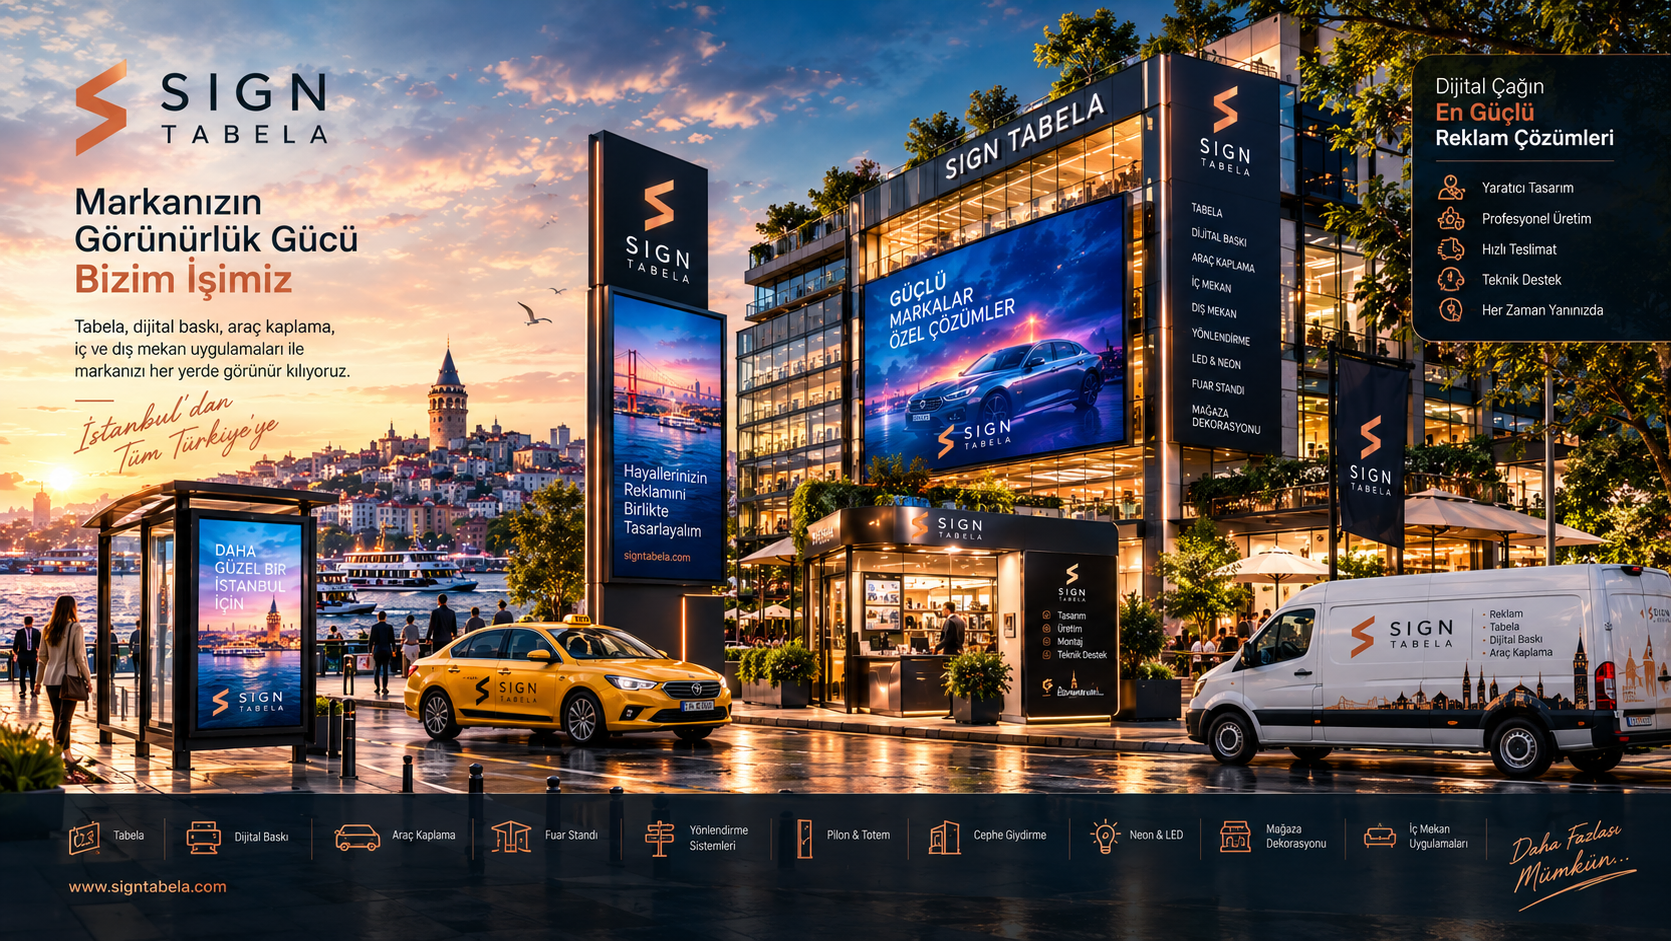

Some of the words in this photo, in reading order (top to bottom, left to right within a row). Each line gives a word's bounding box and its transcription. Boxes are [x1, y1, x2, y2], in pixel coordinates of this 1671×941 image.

[945, 137, 998, 180] SIGN
[1008, 93, 1105, 152] TABELA
[1200, 138, 1250, 164] SIGN
[1201, 159, 1250, 177] TABELA
[1192, 203, 1222, 218] TABELA
[1192, 227, 1221, 242] DİJİTAL
[1224, 234, 1246, 247] BASKI
[625, 234, 691, 270] SIGN
[1192, 253, 1214, 267] ARAÇ
[1216, 257, 1255, 273] KAPLAMA
[627, 259, 690, 284] TABELA
[890, 271, 947, 308] GÜÇLÜ
[1192, 276, 1200, 290] İÇ
[1202, 280, 1231, 293] MEKAN
[890, 286, 974, 329] MARKALAR
[1192, 303, 1205, 315] DIŞ
[1208, 305, 1236, 318] MEKAN
[890, 325, 924, 349] ÖZEL
[928, 298, 1015, 342] ÇÖZÜMLER
[1192, 327, 1250, 346] YÖNLENDİRME
[1192, 354, 1207, 364] LED
[1210, 356, 1215, 365] &
[1218, 358, 1241, 369] NEON
[1192, 379, 1213, 390] FUAR
[1216, 382, 1244, 395] STANDI
[1192, 404, 1229, 418] MAĞAZA
[965, 419, 1010, 439] SIGN
[1193, 415, 1260, 434] DEKORASYONU
[965, 437, 1011, 450] TABELA
[624, 464, 707, 485] Hayallerinizin
[1350, 465, 1391, 484] SIGN
[1351, 483, 1391, 496] TABELA
[625, 502, 668, 517] Birlikte
[624, 520, 701, 539] Tasarlayalım
[938, 518, 981, 531] SIGN
[216, 544, 256, 557] DAHA
[624, 551, 690, 562] signtabela.com
[215, 560, 260, 575] GÜZEL
[265, 563, 286, 575] BİR
[215, 577, 285, 593] İSTANBUL
[215, 595, 244, 615] İÇİN
[1490, 609, 1523, 618] Reklam
[1391, 620, 1452, 636] SIGN
[1490, 622, 1519, 631] Tabela
[1391, 640, 1452, 648] TABELA
[1490, 635, 1515, 645] Dijital
[1518, 635, 1542, 643] Baskı
[1490, 649, 1510, 659] Araç
[1513, 648, 1552, 658] Kaplama
[500, 682, 536, 693] SIGN
[240, 692, 282, 703] SIGN
